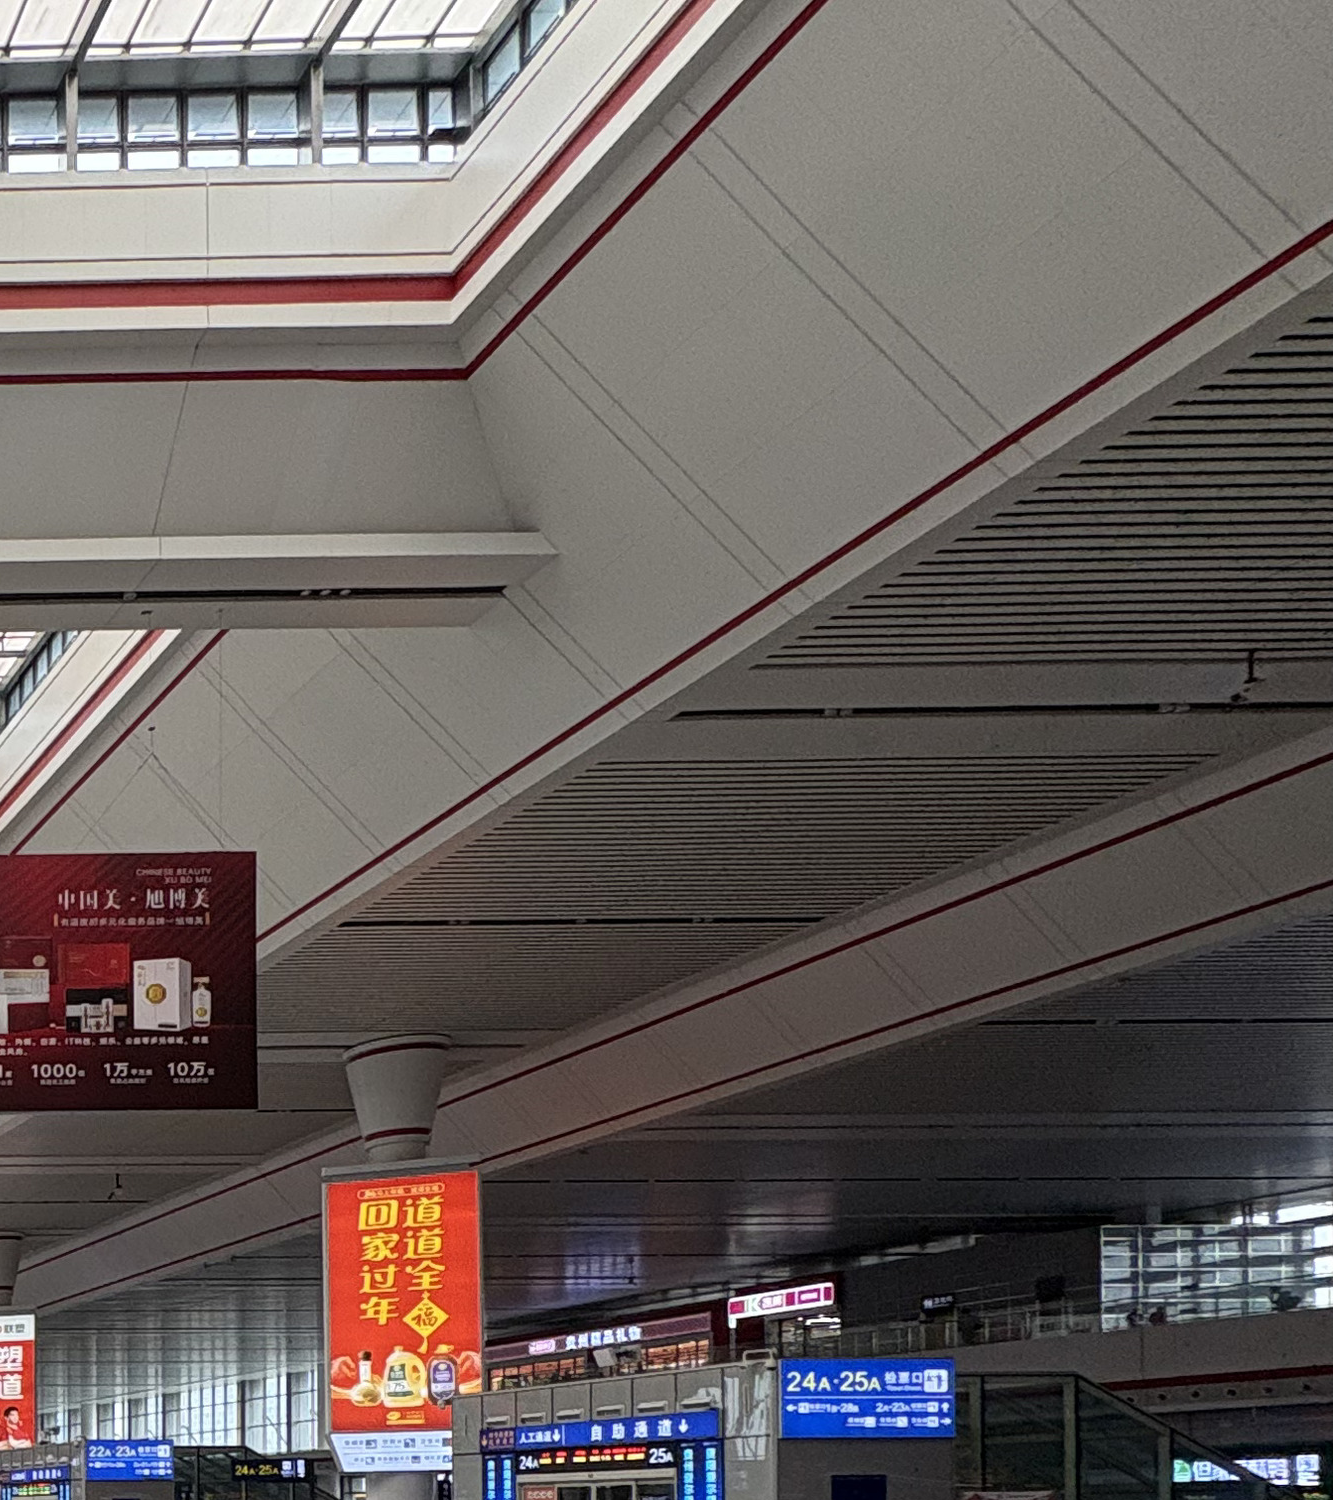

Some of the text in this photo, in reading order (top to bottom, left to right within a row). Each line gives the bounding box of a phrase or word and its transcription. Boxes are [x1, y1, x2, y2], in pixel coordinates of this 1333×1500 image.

[358, 1198, 400, 1325] 回家过年
[402, 1195, 446, 1292] 道道全
[591, 1419, 672, 1442] 自助通道
